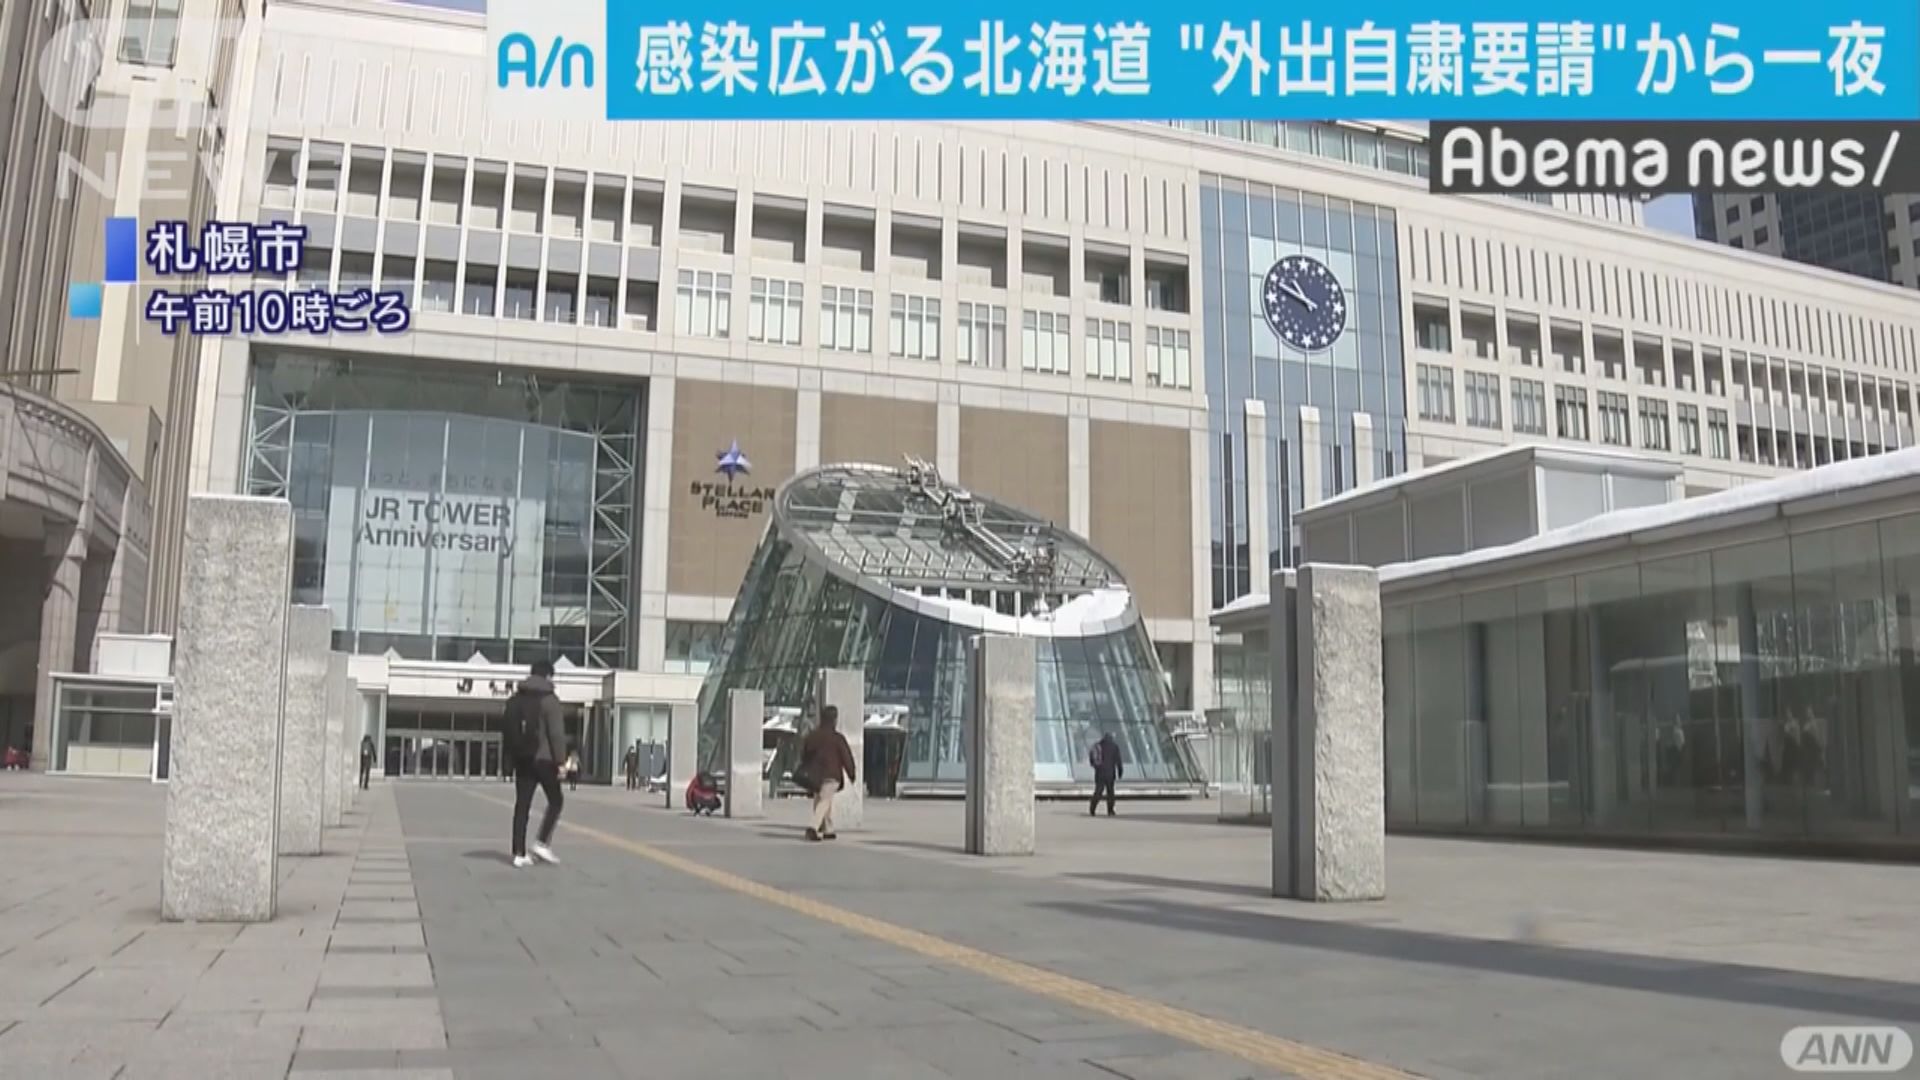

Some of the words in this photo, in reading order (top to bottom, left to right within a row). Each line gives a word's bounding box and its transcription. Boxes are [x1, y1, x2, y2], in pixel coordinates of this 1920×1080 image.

[366, 496, 400, 521] JR
[407, 499, 511, 527] TOWER
[356, 521, 514, 559] Anniversary
